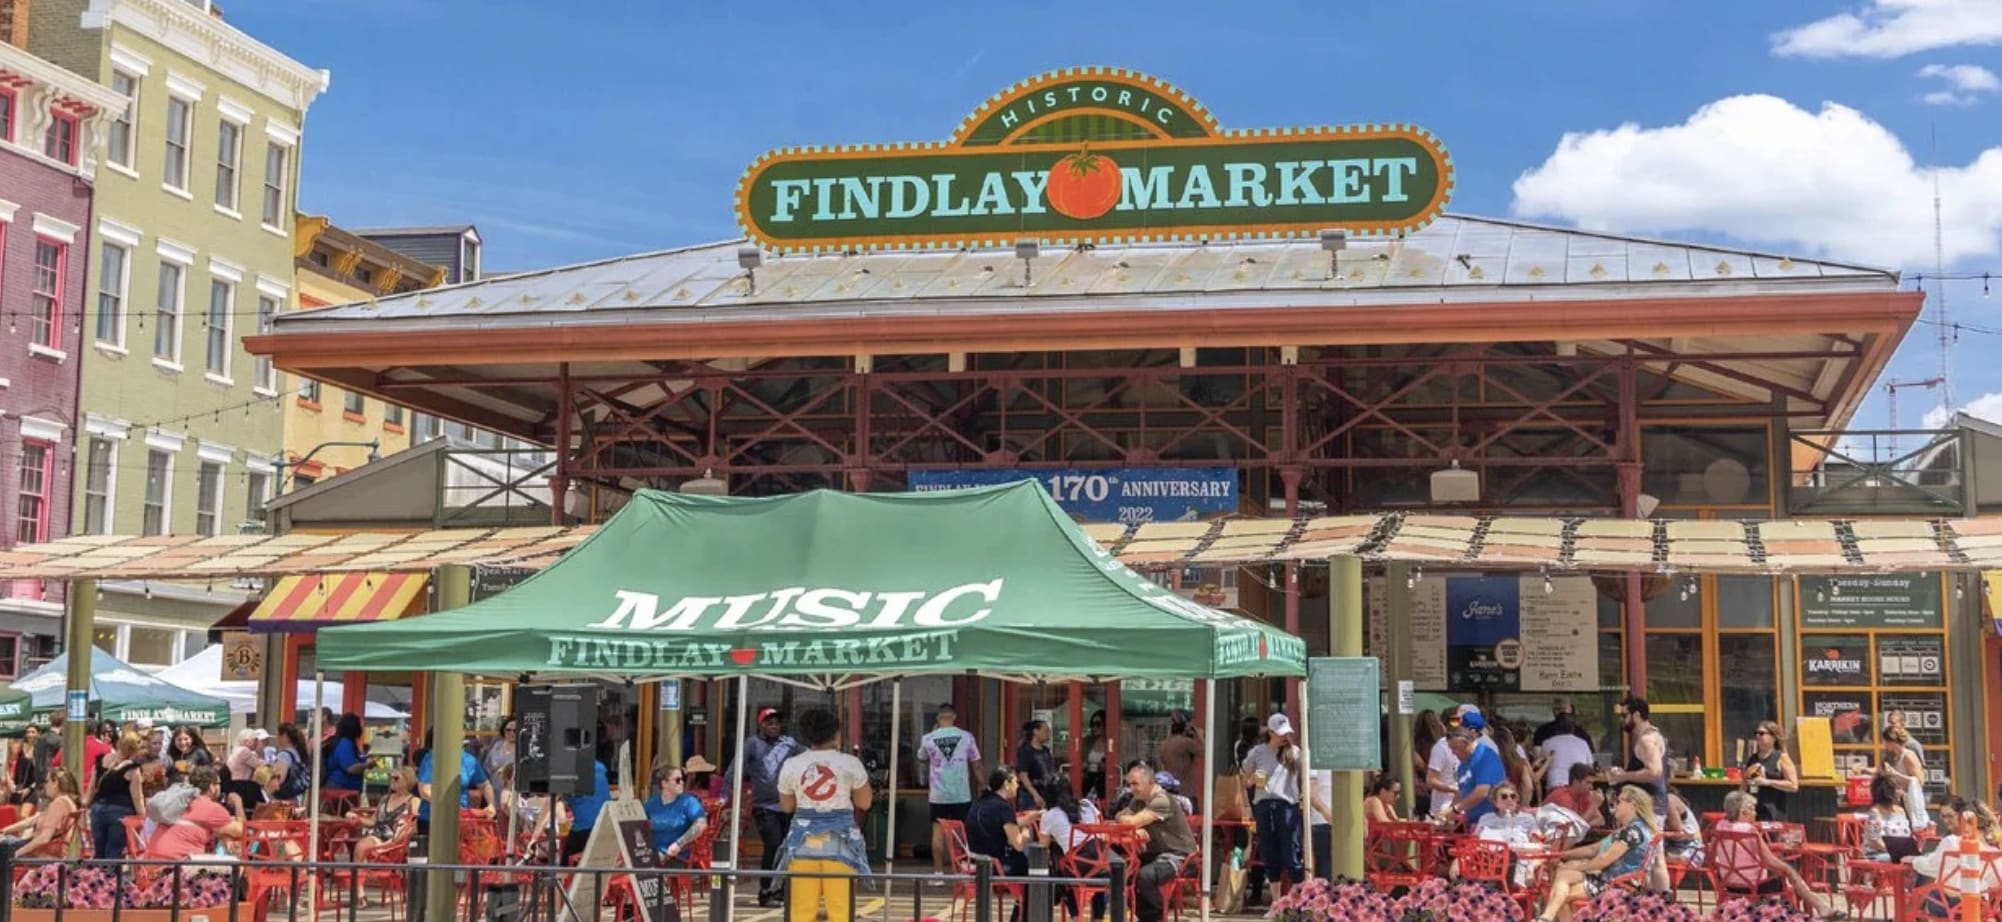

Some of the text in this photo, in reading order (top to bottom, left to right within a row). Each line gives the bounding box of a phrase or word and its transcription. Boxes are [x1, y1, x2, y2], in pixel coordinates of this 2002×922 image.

[1001, 87, 1173, 129] HISTORIC
[769, 156, 1418, 222] FINDLAY MARKET
[1121, 480, 1231, 497] ANNIVERSARY
[1118, 506, 1153, 523] 2022
[587, 579, 1004, 630] MUSIC
[1462, 600, 1504, 619] Jane's
[546, 630, 959, 667] FINDLAY MARKET
[1809, 659, 1861, 673] KARRIKIN
[174, 710, 217, 724] MARKET
